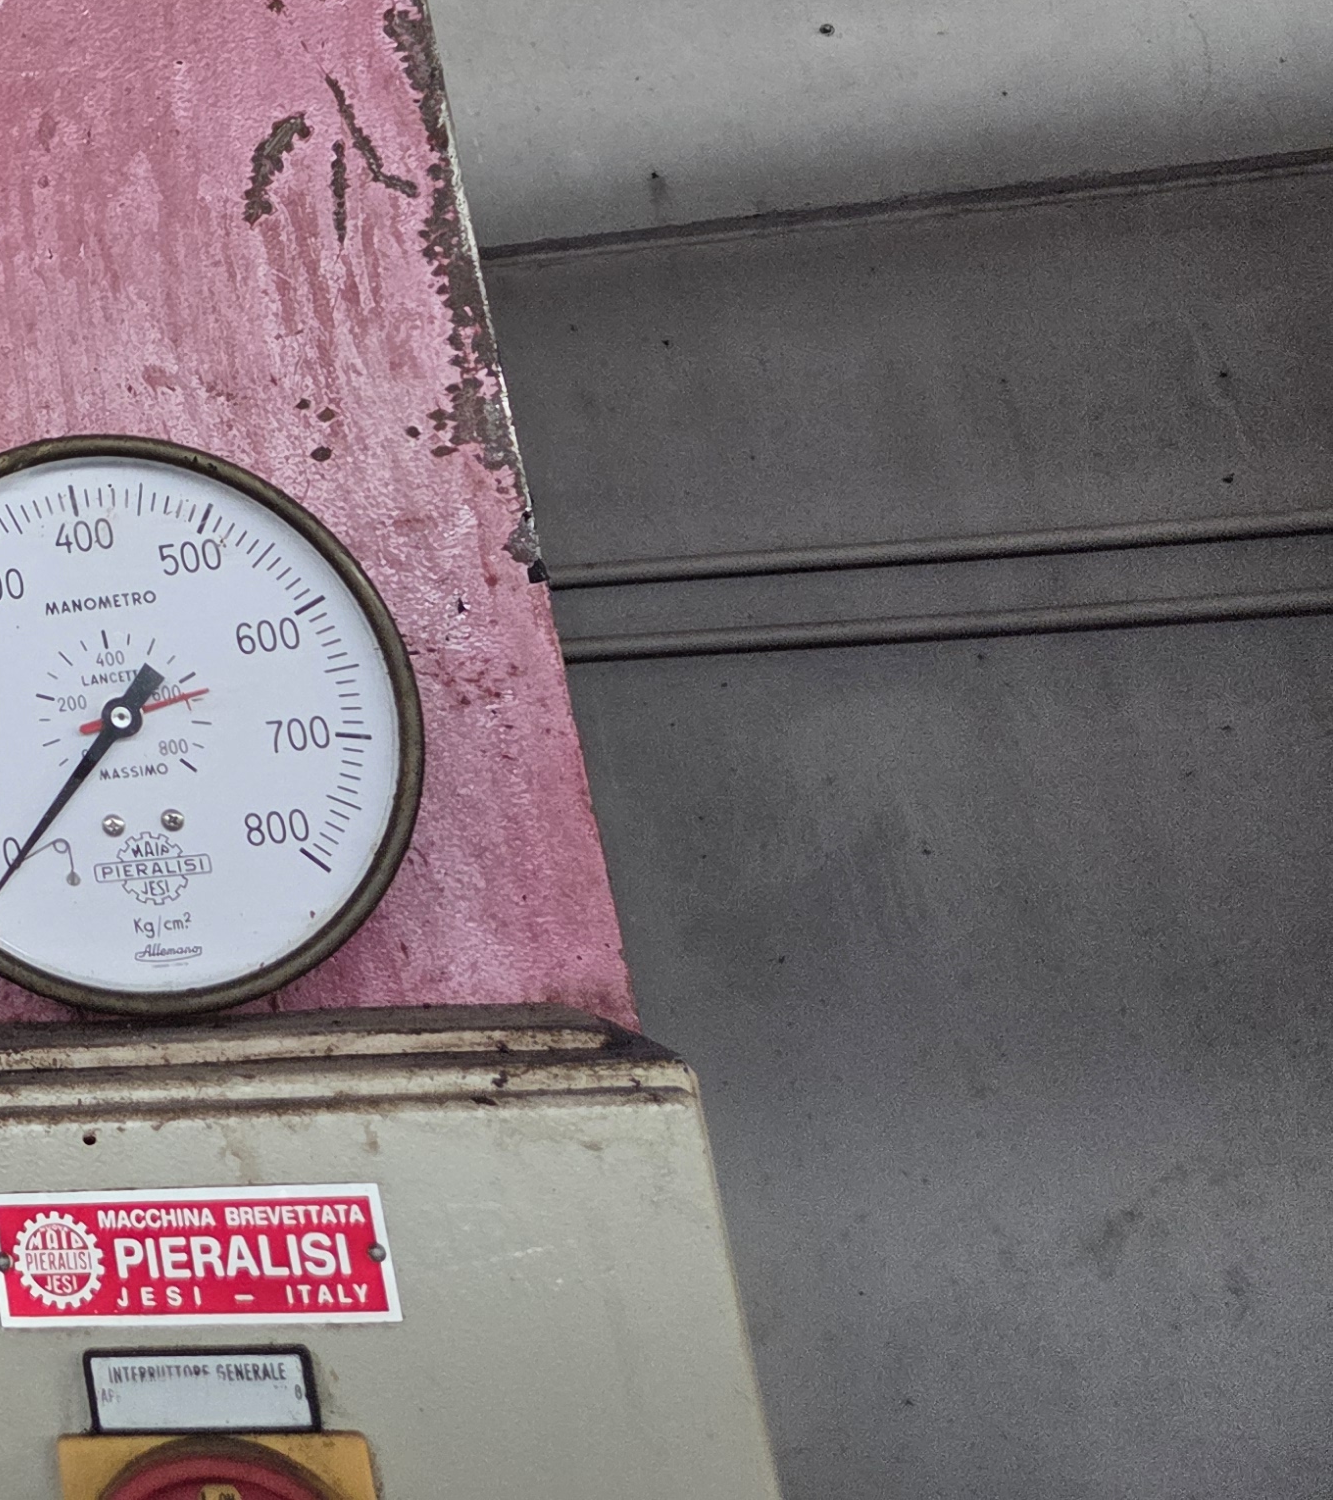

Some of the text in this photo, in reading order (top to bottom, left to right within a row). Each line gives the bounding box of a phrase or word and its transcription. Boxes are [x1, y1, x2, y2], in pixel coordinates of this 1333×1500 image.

[55, 517, 114, 553] 400
[158, 539, 222, 576] 500
[45, 590, 157, 616] MANOMETRO
[236, 617, 301, 655] 600
[96, 650, 126, 668] 400
[81, 669, 139, 687] LANCETT
[57, 694, 88, 713] 200
[265, 715, 331, 754] 700
[158, 739, 189, 757] 800
[99, 763, 169, 781] MASSIMO
[244, 808, 310, 847] 800
[130, 840, 170, 859] MAIP
[101, 857, 205, 880] PIERALISI
[140, 878, 171, 897] JESI
[97, 1203, 366, 1230] MACCHINA BREVETTATA
[25, 1251, 93, 1271] PIERALISI
[114, 1232, 353, 1280] PIERALISI
[44, 1274, 78, 1294] JESI
[285, 1283, 369, 1306] ITALY
